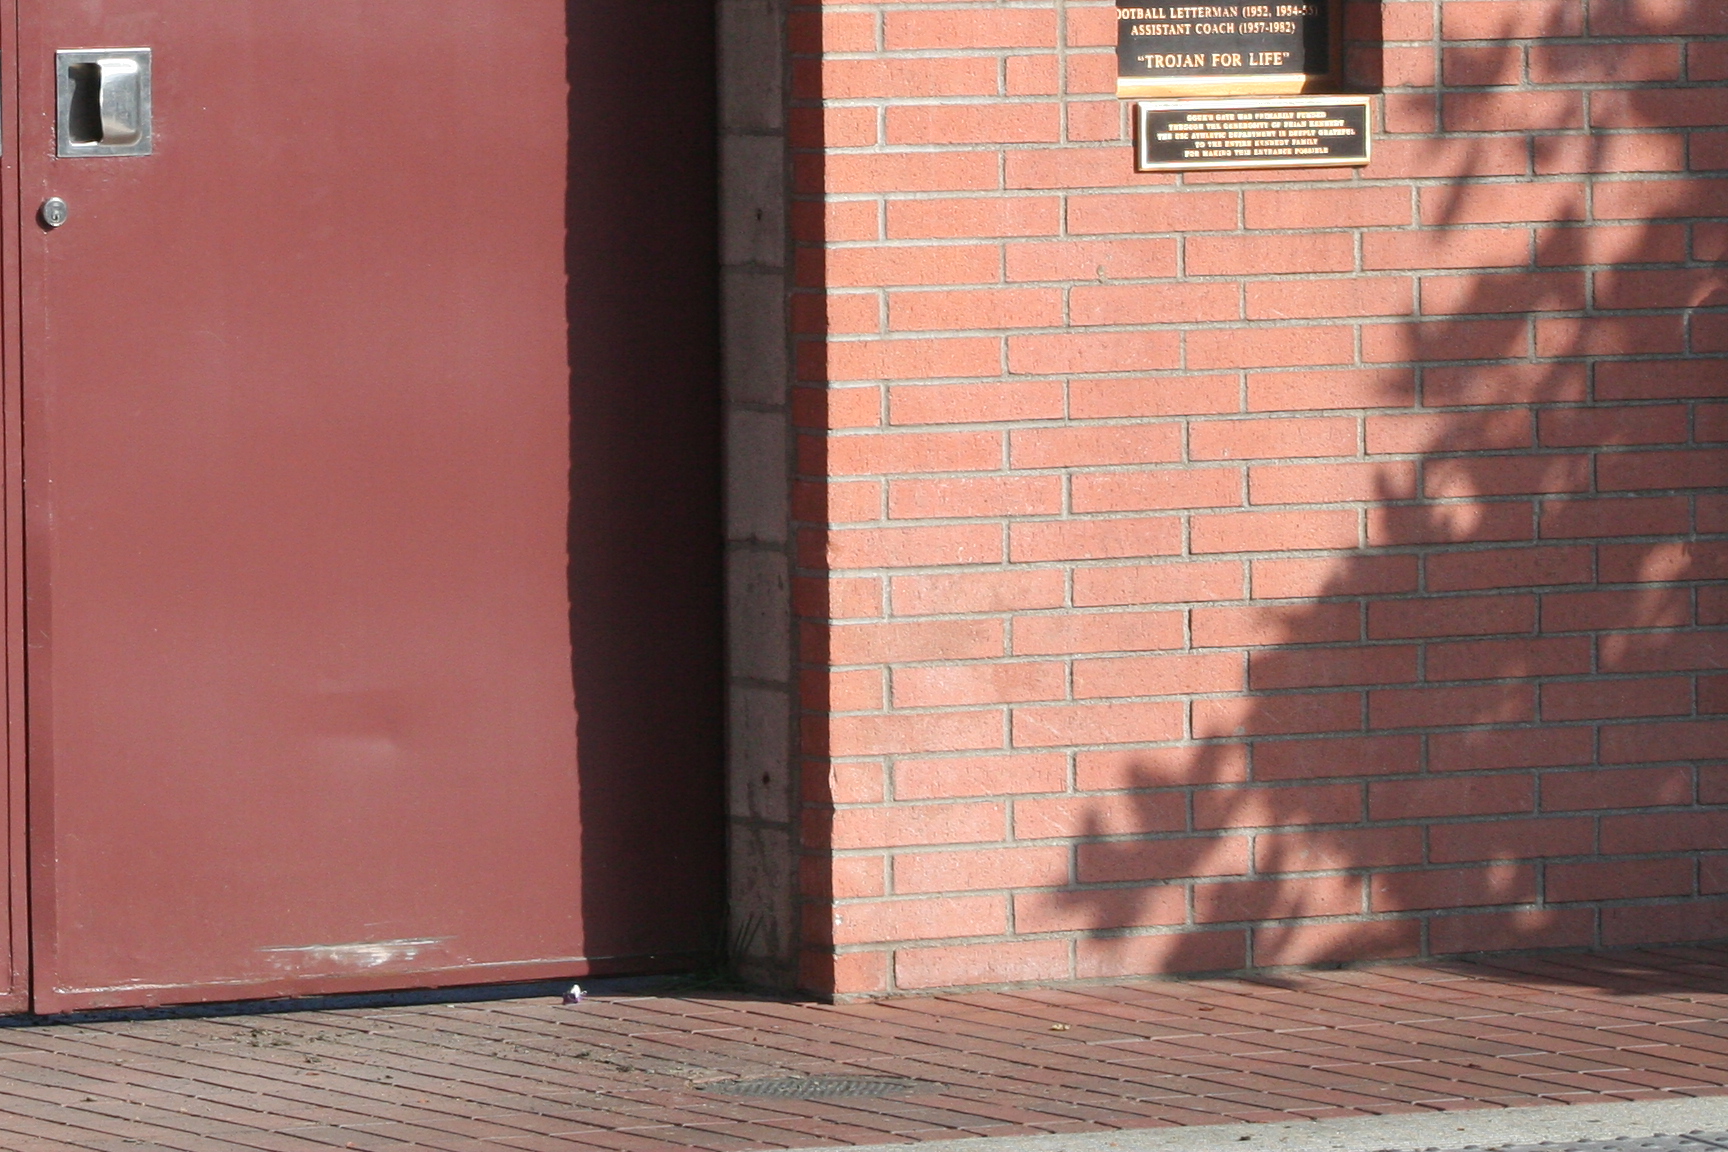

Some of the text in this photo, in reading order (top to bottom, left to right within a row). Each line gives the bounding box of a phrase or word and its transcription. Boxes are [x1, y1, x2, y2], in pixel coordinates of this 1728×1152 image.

[1117, 7, 1166, 20] OOTBALL
[1170, 6, 1238, 19] LETTERMAN
[1131, 24, 1191, 35] ASSISTANT
[1196, 23, 1234, 34] COACH
[1138, 52, 1289, 68] "TROJAN FOR LIFE"
